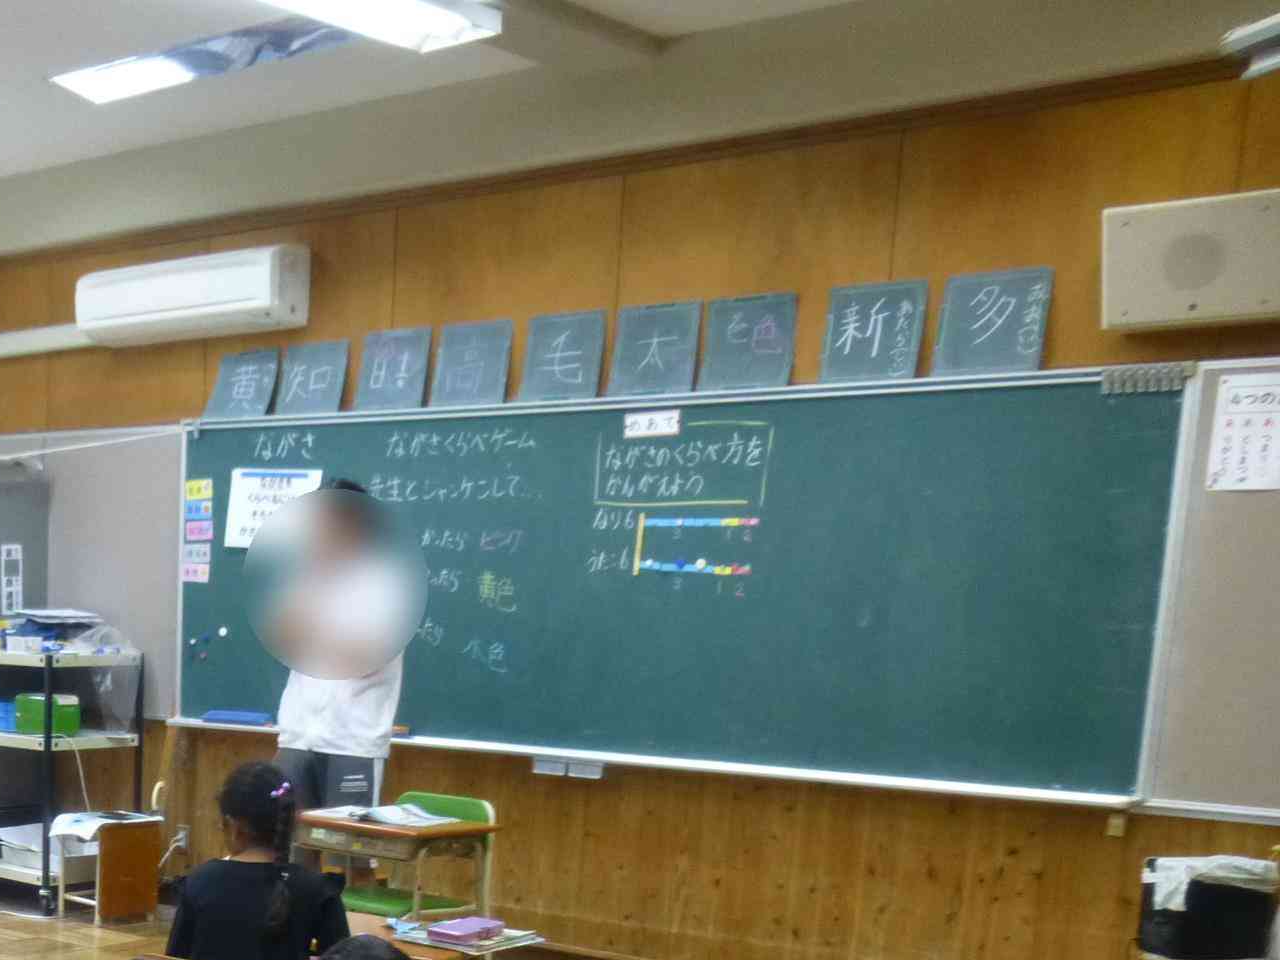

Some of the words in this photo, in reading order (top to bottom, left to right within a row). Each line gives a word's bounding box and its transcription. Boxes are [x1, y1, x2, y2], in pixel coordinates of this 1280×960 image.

[835, 297, 892, 358] 新
[969, 285, 1017, 345] 多
[543, 329, 584, 384] 毛
[285, 363, 334, 402] 知
[254, 431, 317, 461] ながさ
[604, 431, 763, 471] ながさのくらべ方を
